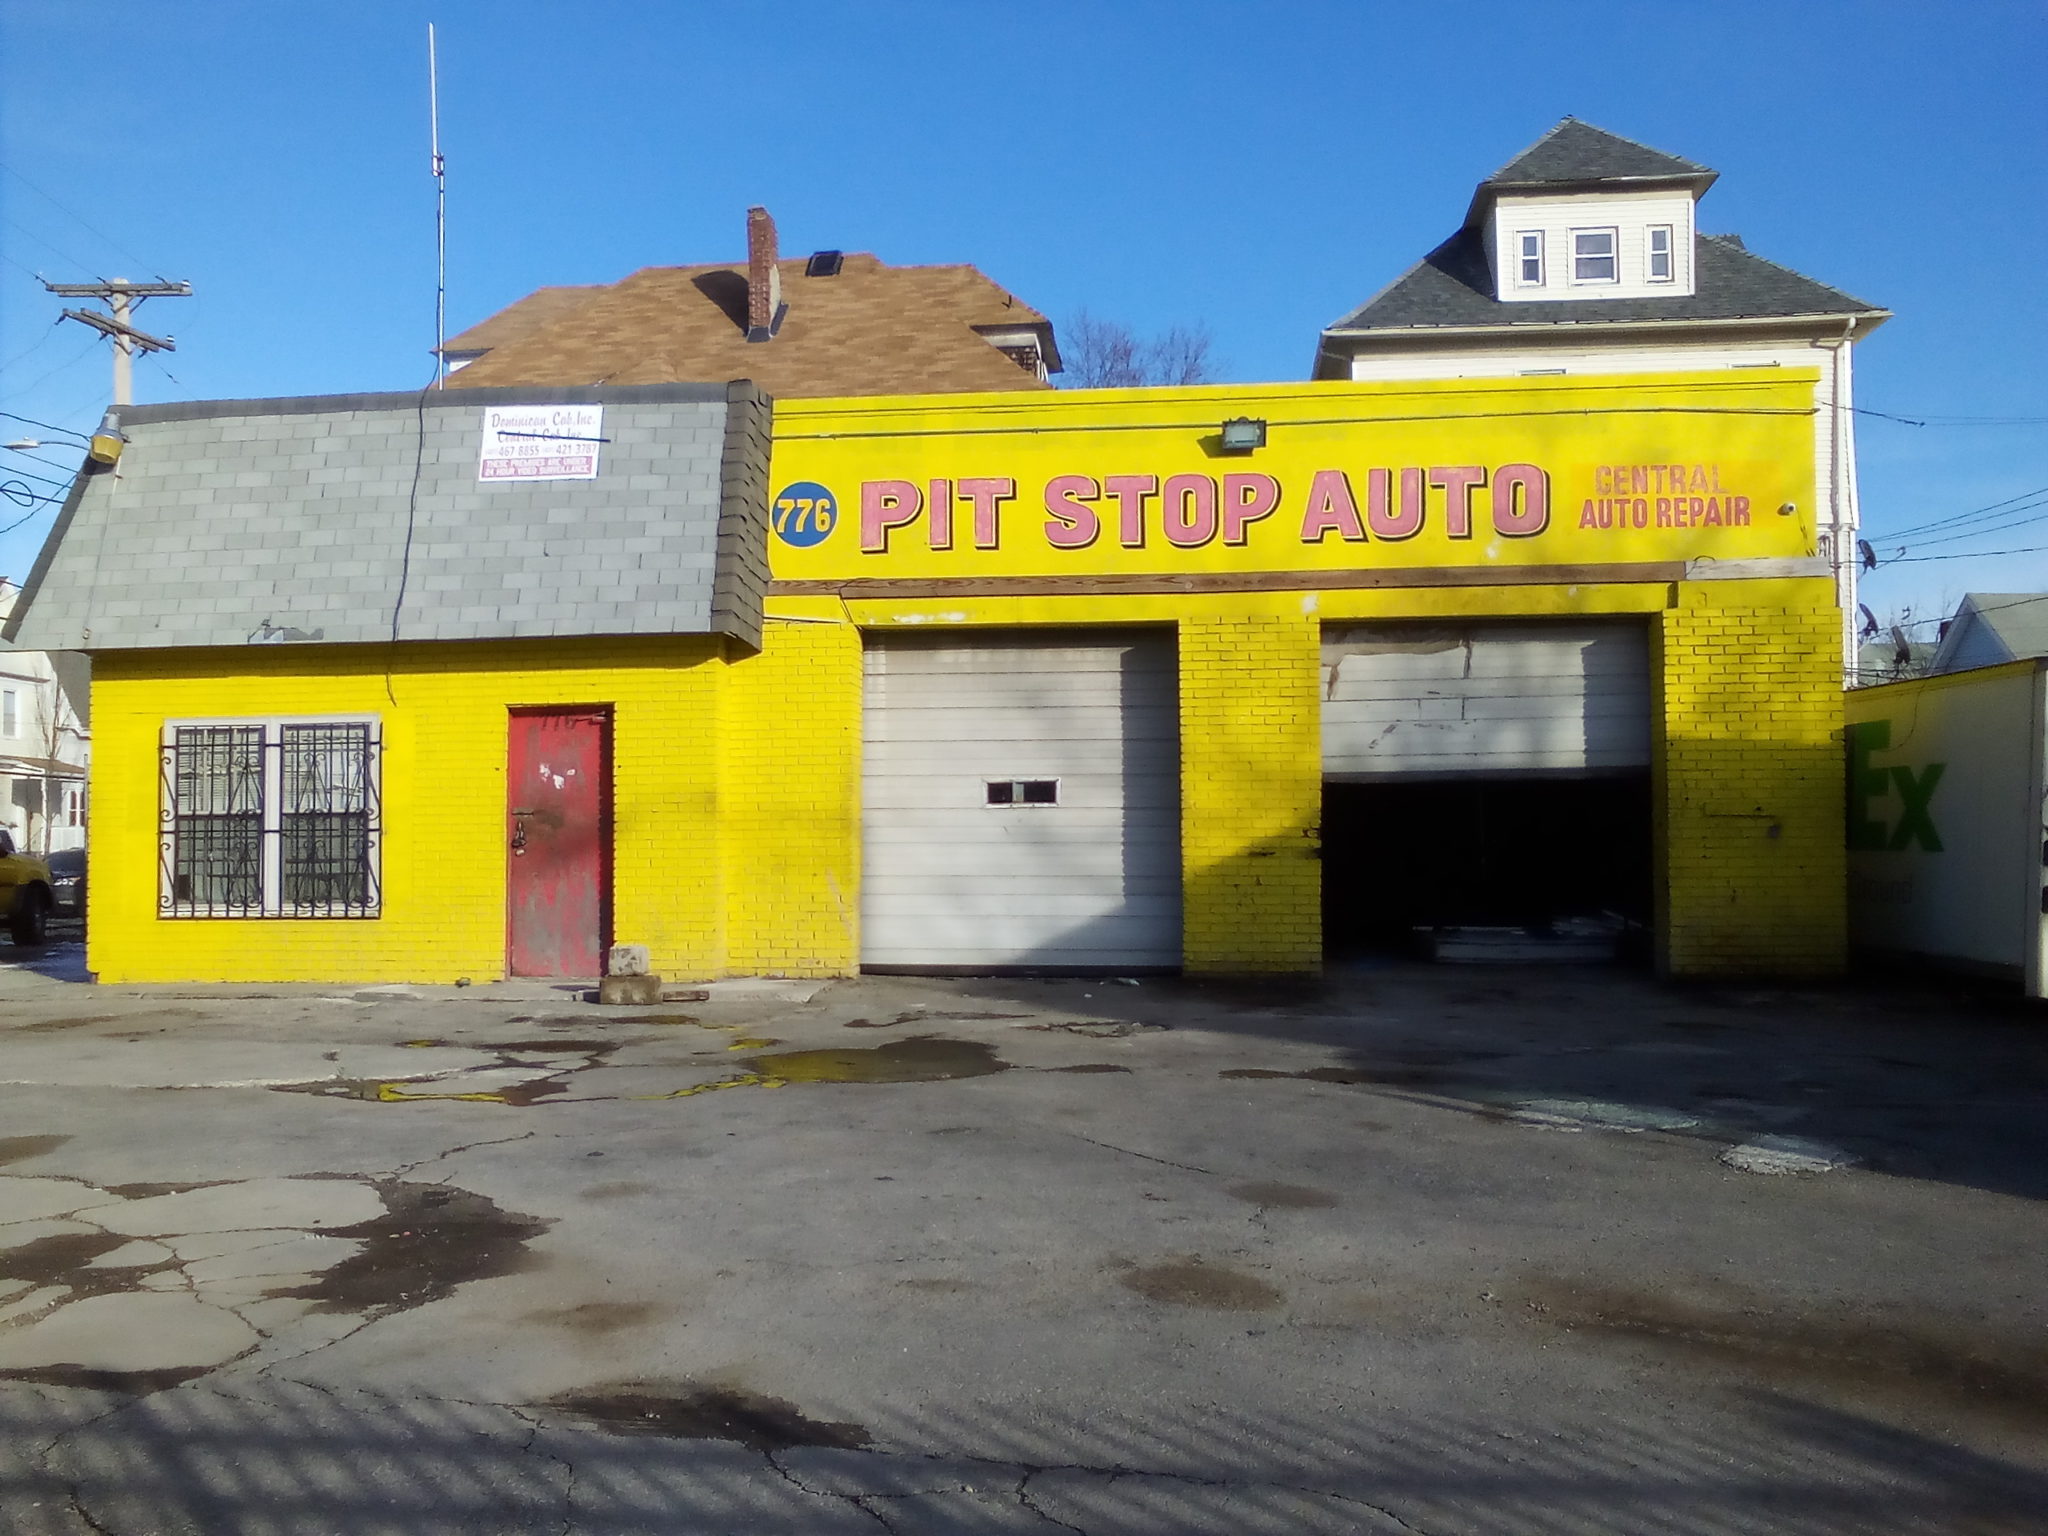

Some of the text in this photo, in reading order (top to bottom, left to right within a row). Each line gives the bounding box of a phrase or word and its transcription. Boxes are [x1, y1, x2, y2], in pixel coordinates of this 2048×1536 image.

[491, 413, 546, 428] Dominican
[1595, 464, 1729, 496] CENTRAL
[773, 498, 833, 535] 776
[860, 462, 1550, 556] PIT STOP AUTO
[1579, 495, 1751, 530] AUTO REPAIR
